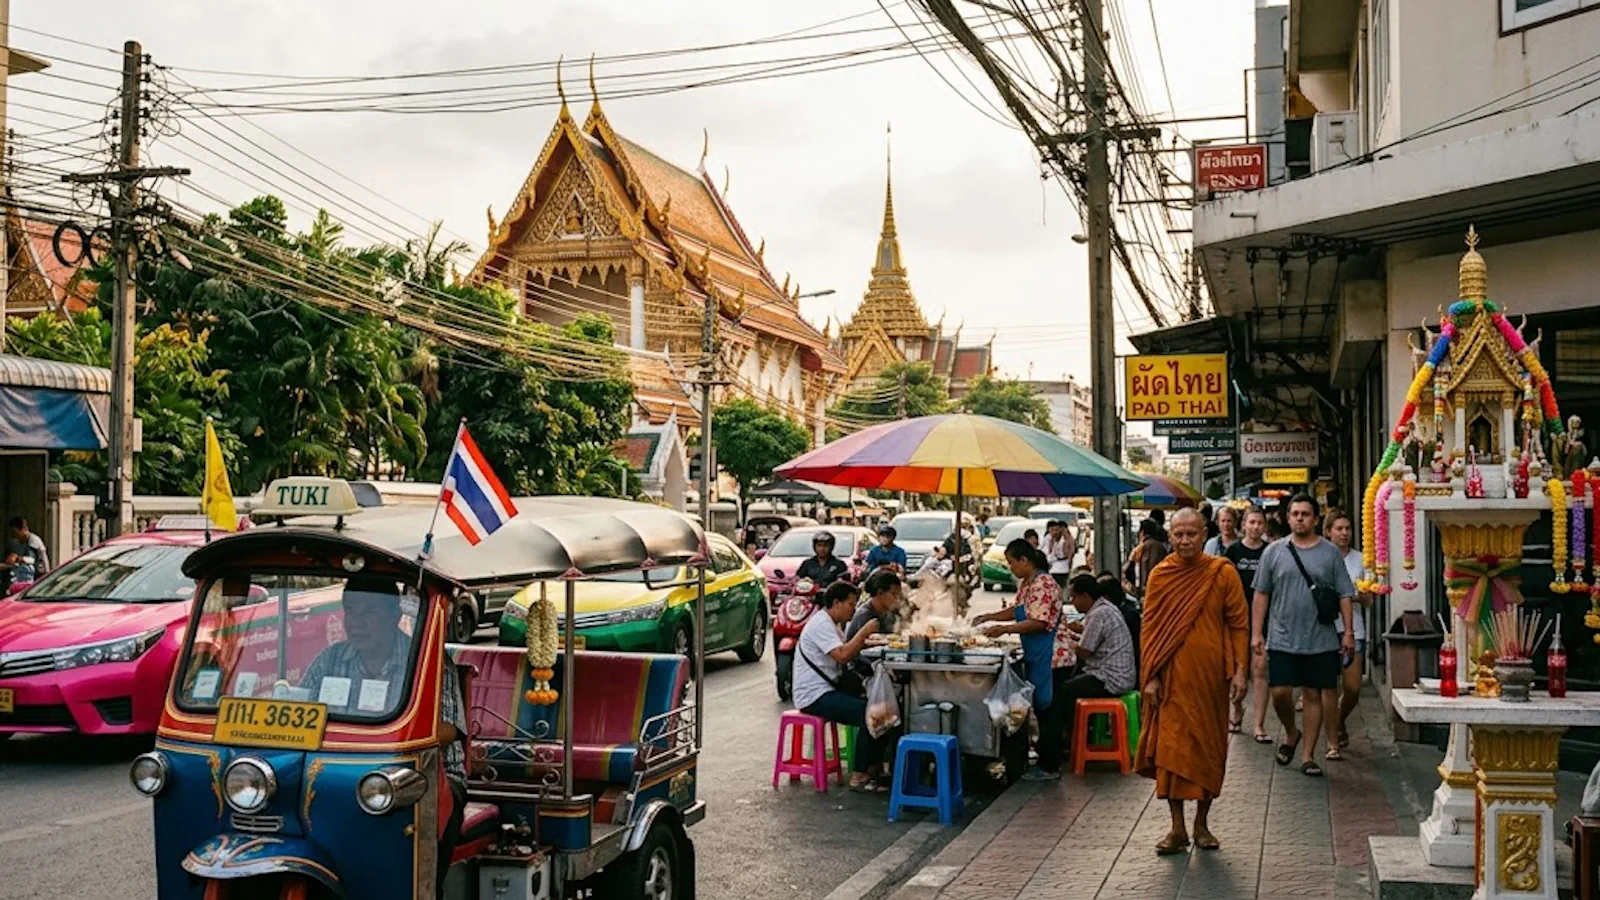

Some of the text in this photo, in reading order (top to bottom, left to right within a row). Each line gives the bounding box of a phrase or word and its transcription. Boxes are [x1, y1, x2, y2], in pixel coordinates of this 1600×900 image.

[1132, 360, 1222, 397] ผัดไทย
[1132, 400, 1223, 416] PAD THAI
[277, 485, 329, 506] TUKI
[263, 704, 319, 729] 3632
